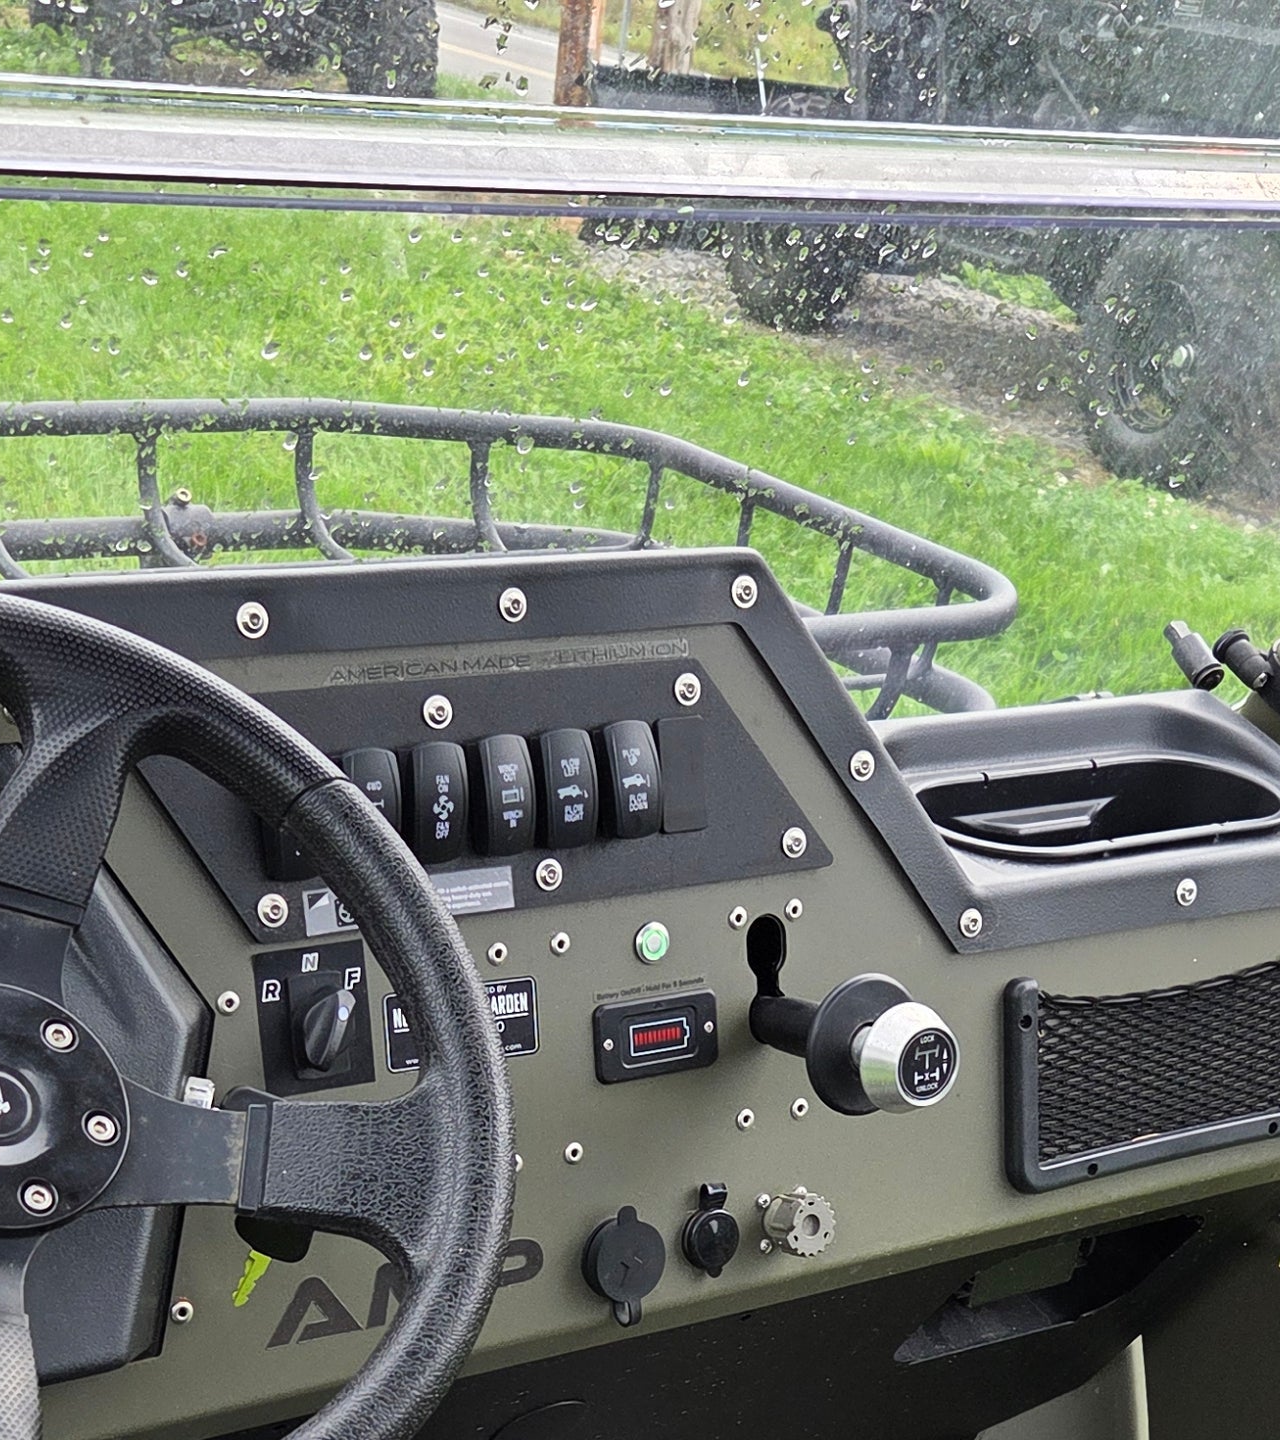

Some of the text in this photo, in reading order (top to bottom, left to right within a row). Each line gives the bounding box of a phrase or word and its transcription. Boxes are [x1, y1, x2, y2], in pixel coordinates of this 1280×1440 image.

[330, 638, 688, 682] AMERICAN MADE LITHIUM ION
[435, 774, 450, 785] FAN
[437, 784, 449, 794] ON
[435, 821, 450, 832] FAN
[435, 829, 450, 840] OFF
[301, 952, 319, 972] N
[344, 967, 362, 990] F
[261, 979, 281, 1003] R
[489, 992, 529, 1016] ARDEN
[920, 1035, 935, 1044] LOCK
[916, 1082, 939, 1093] UNLOCK
